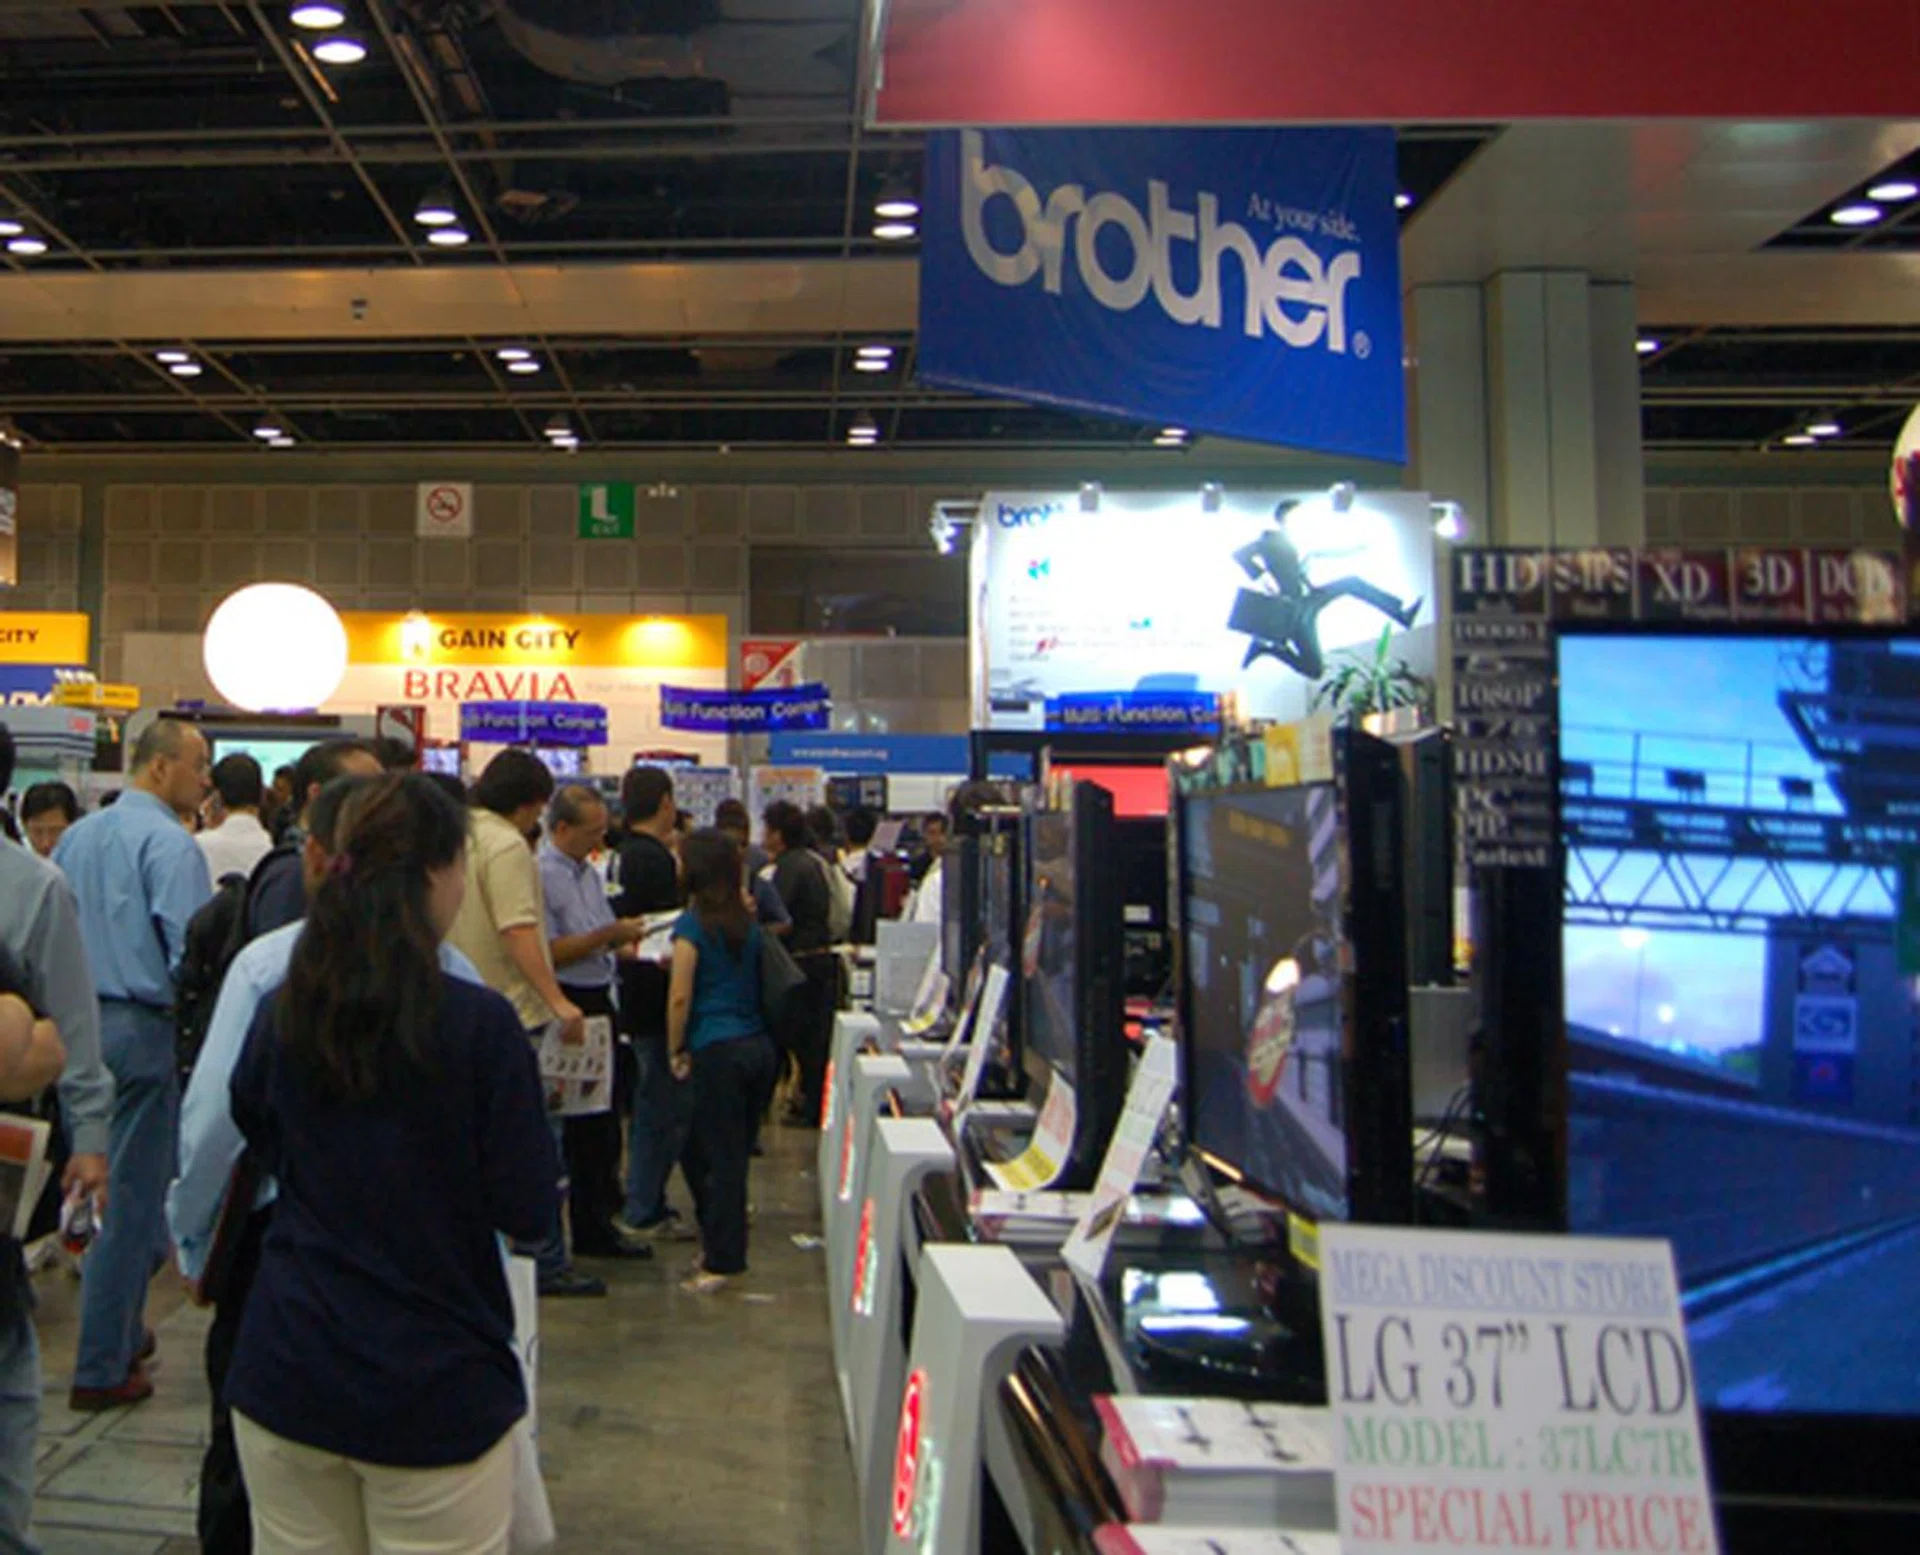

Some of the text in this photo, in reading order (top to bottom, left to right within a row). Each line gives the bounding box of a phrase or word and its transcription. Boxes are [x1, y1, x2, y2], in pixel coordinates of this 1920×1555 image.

[960, 129, 1361, 353] brother
[1652, 562, 1711, 602] XD
[1746, 554, 1795, 595] 3D
[438, 628, 505, 650] GAIN
[403, 669, 578, 701] BRAVIA
[1332, 1248, 1669, 1312] MEGA DISCOUNT STORE
[1333, 1313, 1420, 1406] LG
[1547, 1323, 1689, 1416] LCD
[1342, 1414, 1505, 1472] MODEL
[1538, 1424, 1698, 1478] 37LC7R
[1350, 1483, 1708, 1554] SPECIAL PRICE
